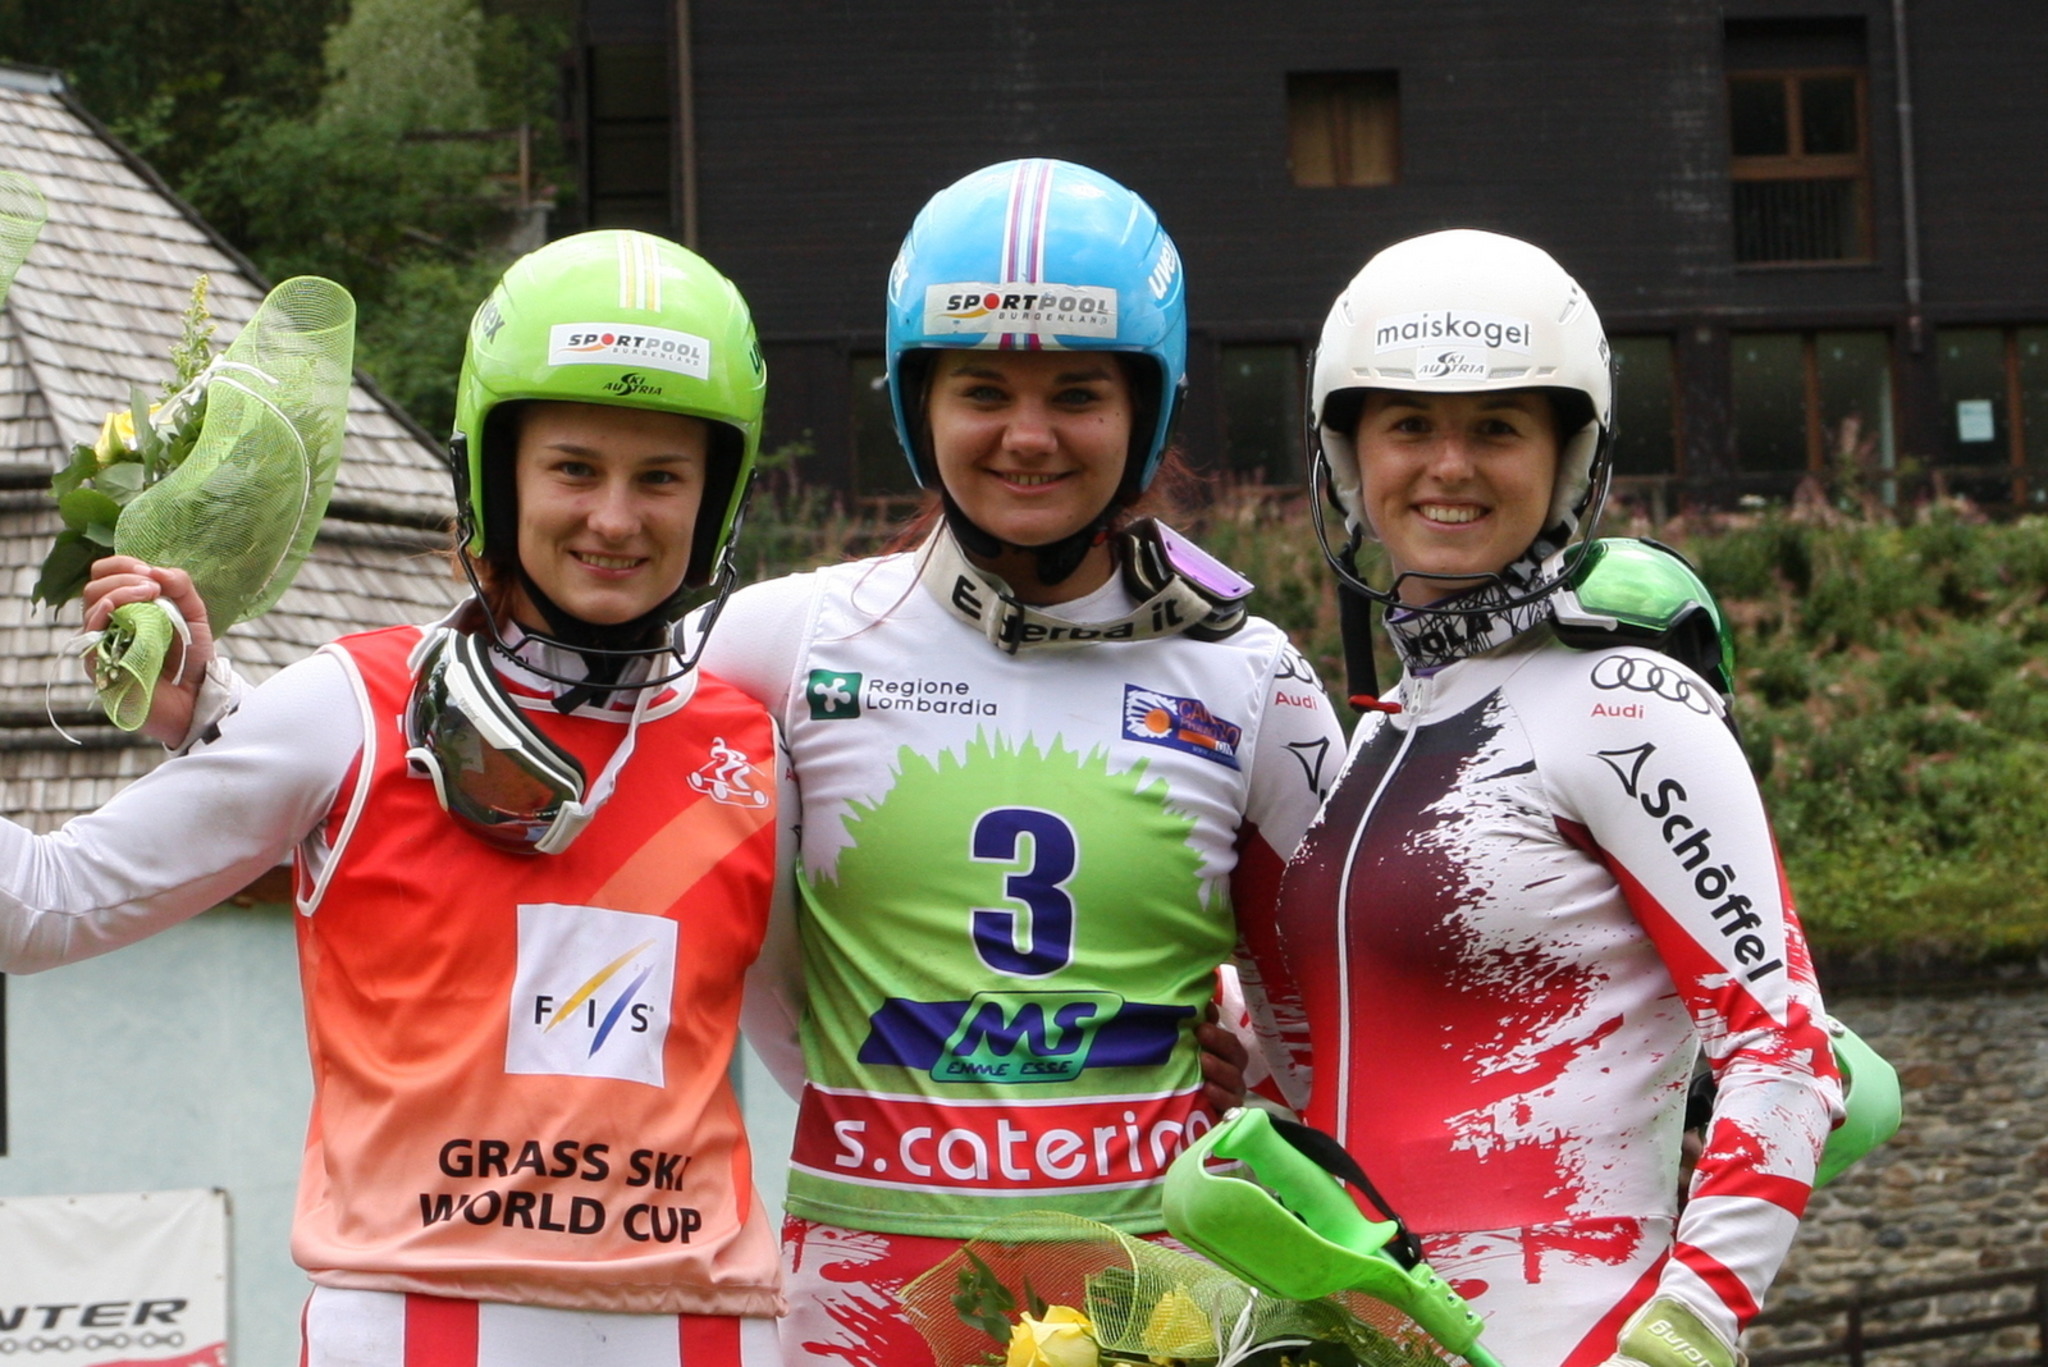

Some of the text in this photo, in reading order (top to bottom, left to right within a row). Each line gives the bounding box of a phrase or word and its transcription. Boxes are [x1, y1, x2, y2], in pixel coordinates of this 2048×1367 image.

[946, 293, 1109, 314] SPORTPOOL
[999, 312, 1107, 325] BURGENLAND
[1377, 312, 1530, 348] maiskogel
[568, 332, 700, 359] SPORTPOOL
[868, 678, 969, 697] Regione
[867, 694, 997, 716] Lombardia
[1275, 691, 1318, 710] Audi
[1591, 703, 1643, 719] Audi
[970, 806, 1079, 979] 3
[952, 1001, 1098, 1057] MS
[1020, 1060, 1073, 1075] ESSE
[438, 1138, 692, 1192] GRASS SKI
[419, 1189, 702, 1244] WORLD CUP
